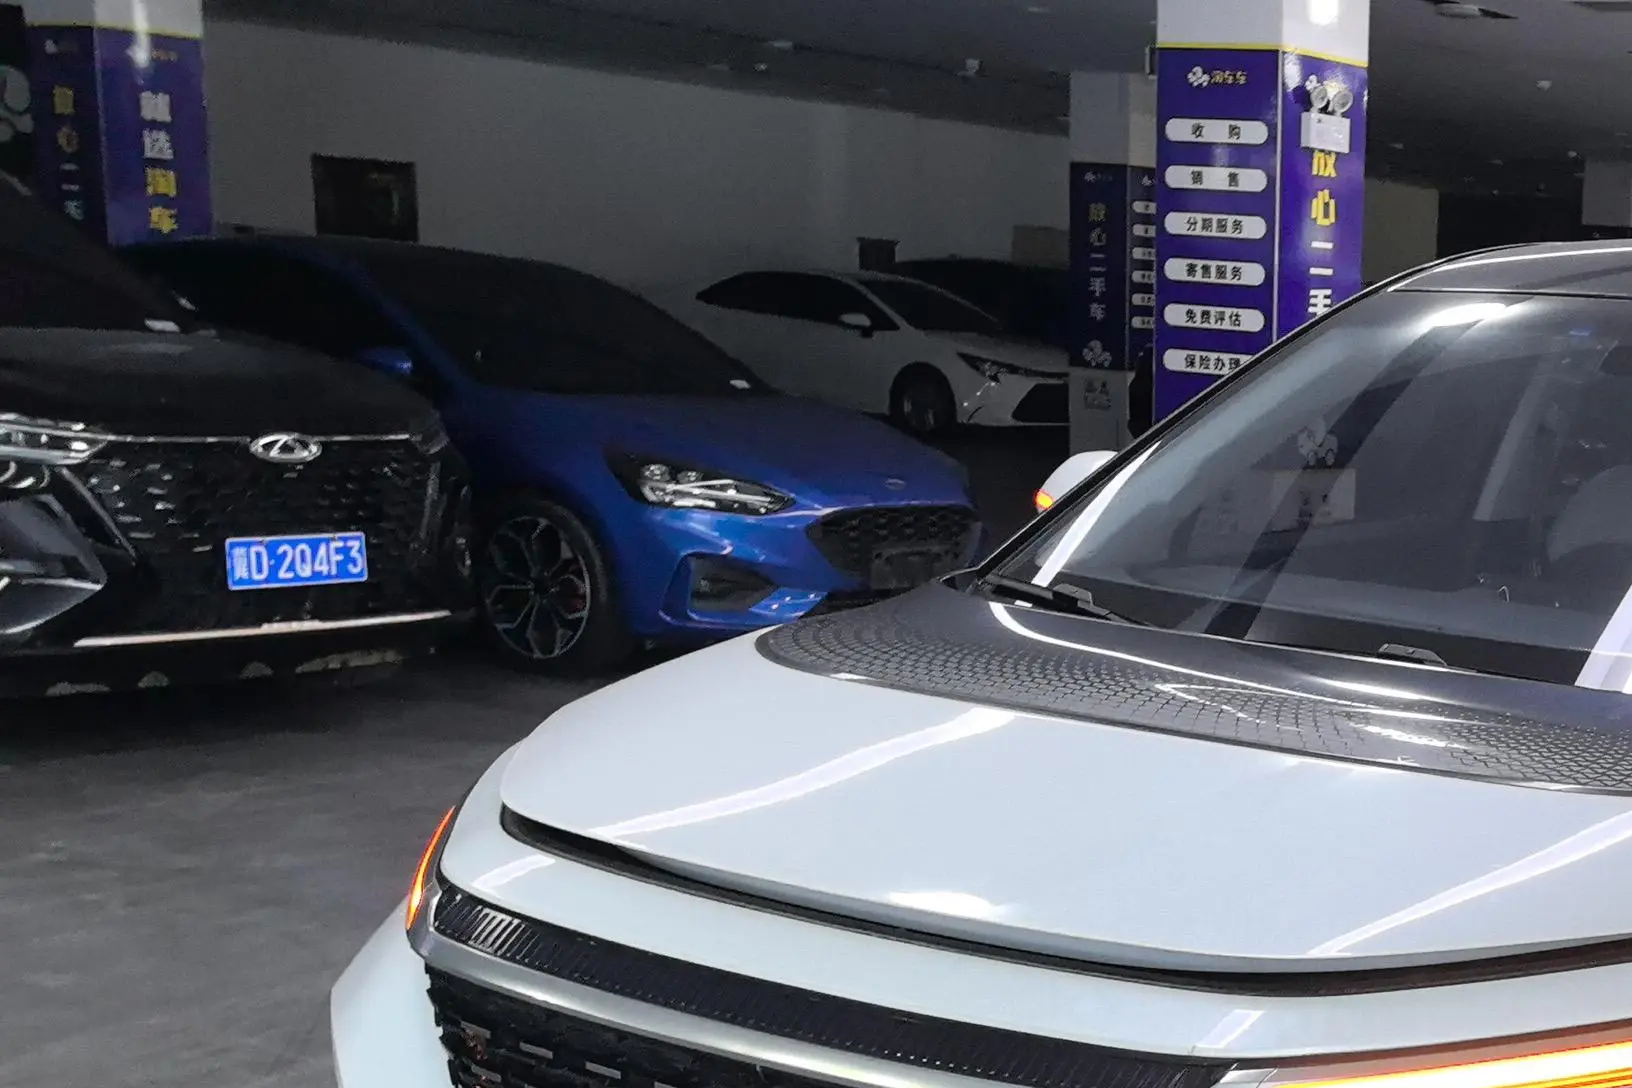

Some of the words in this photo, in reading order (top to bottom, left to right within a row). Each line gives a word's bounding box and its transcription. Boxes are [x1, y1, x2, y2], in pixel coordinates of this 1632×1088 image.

[1186, 216, 1244, 234] 分期服务
[1185, 263, 1242, 281] 寄售服务
[1184, 308, 1241, 327] 免费评估
[1184, 354, 1241, 373] 保险办理
